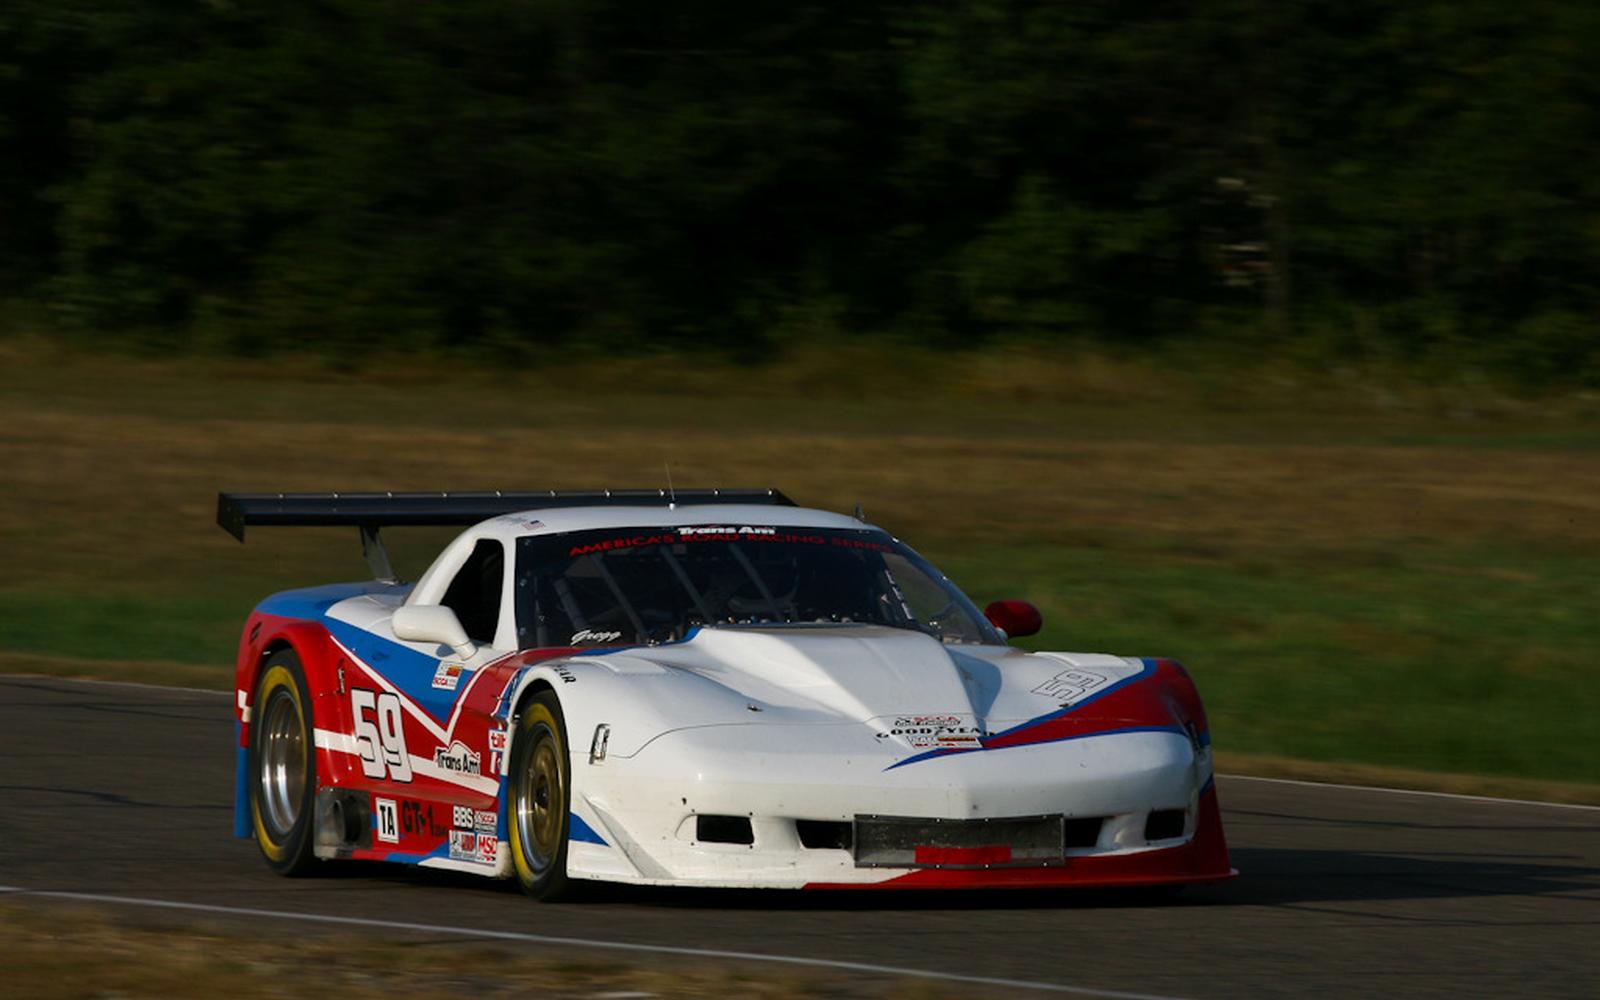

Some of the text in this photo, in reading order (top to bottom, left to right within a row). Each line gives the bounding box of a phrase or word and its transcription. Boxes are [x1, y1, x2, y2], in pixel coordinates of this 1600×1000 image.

[676, 526, 776, 535] Trans Am
[569, 535, 673, 557] AMERICA'S
[681, 533, 739, 543] ROAD
[747, 534, 825, 545] RACING
[570, 629, 621, 646] Gregg
[1030, 669, 1107, 701] 59
[351, 687, 413, 783] 59
[436, 749, 461, 771] Trans
[463, 753, 480, 775] Am
[379, 804, 395, 836] TA
[453, 805, 474, 829] BBS
